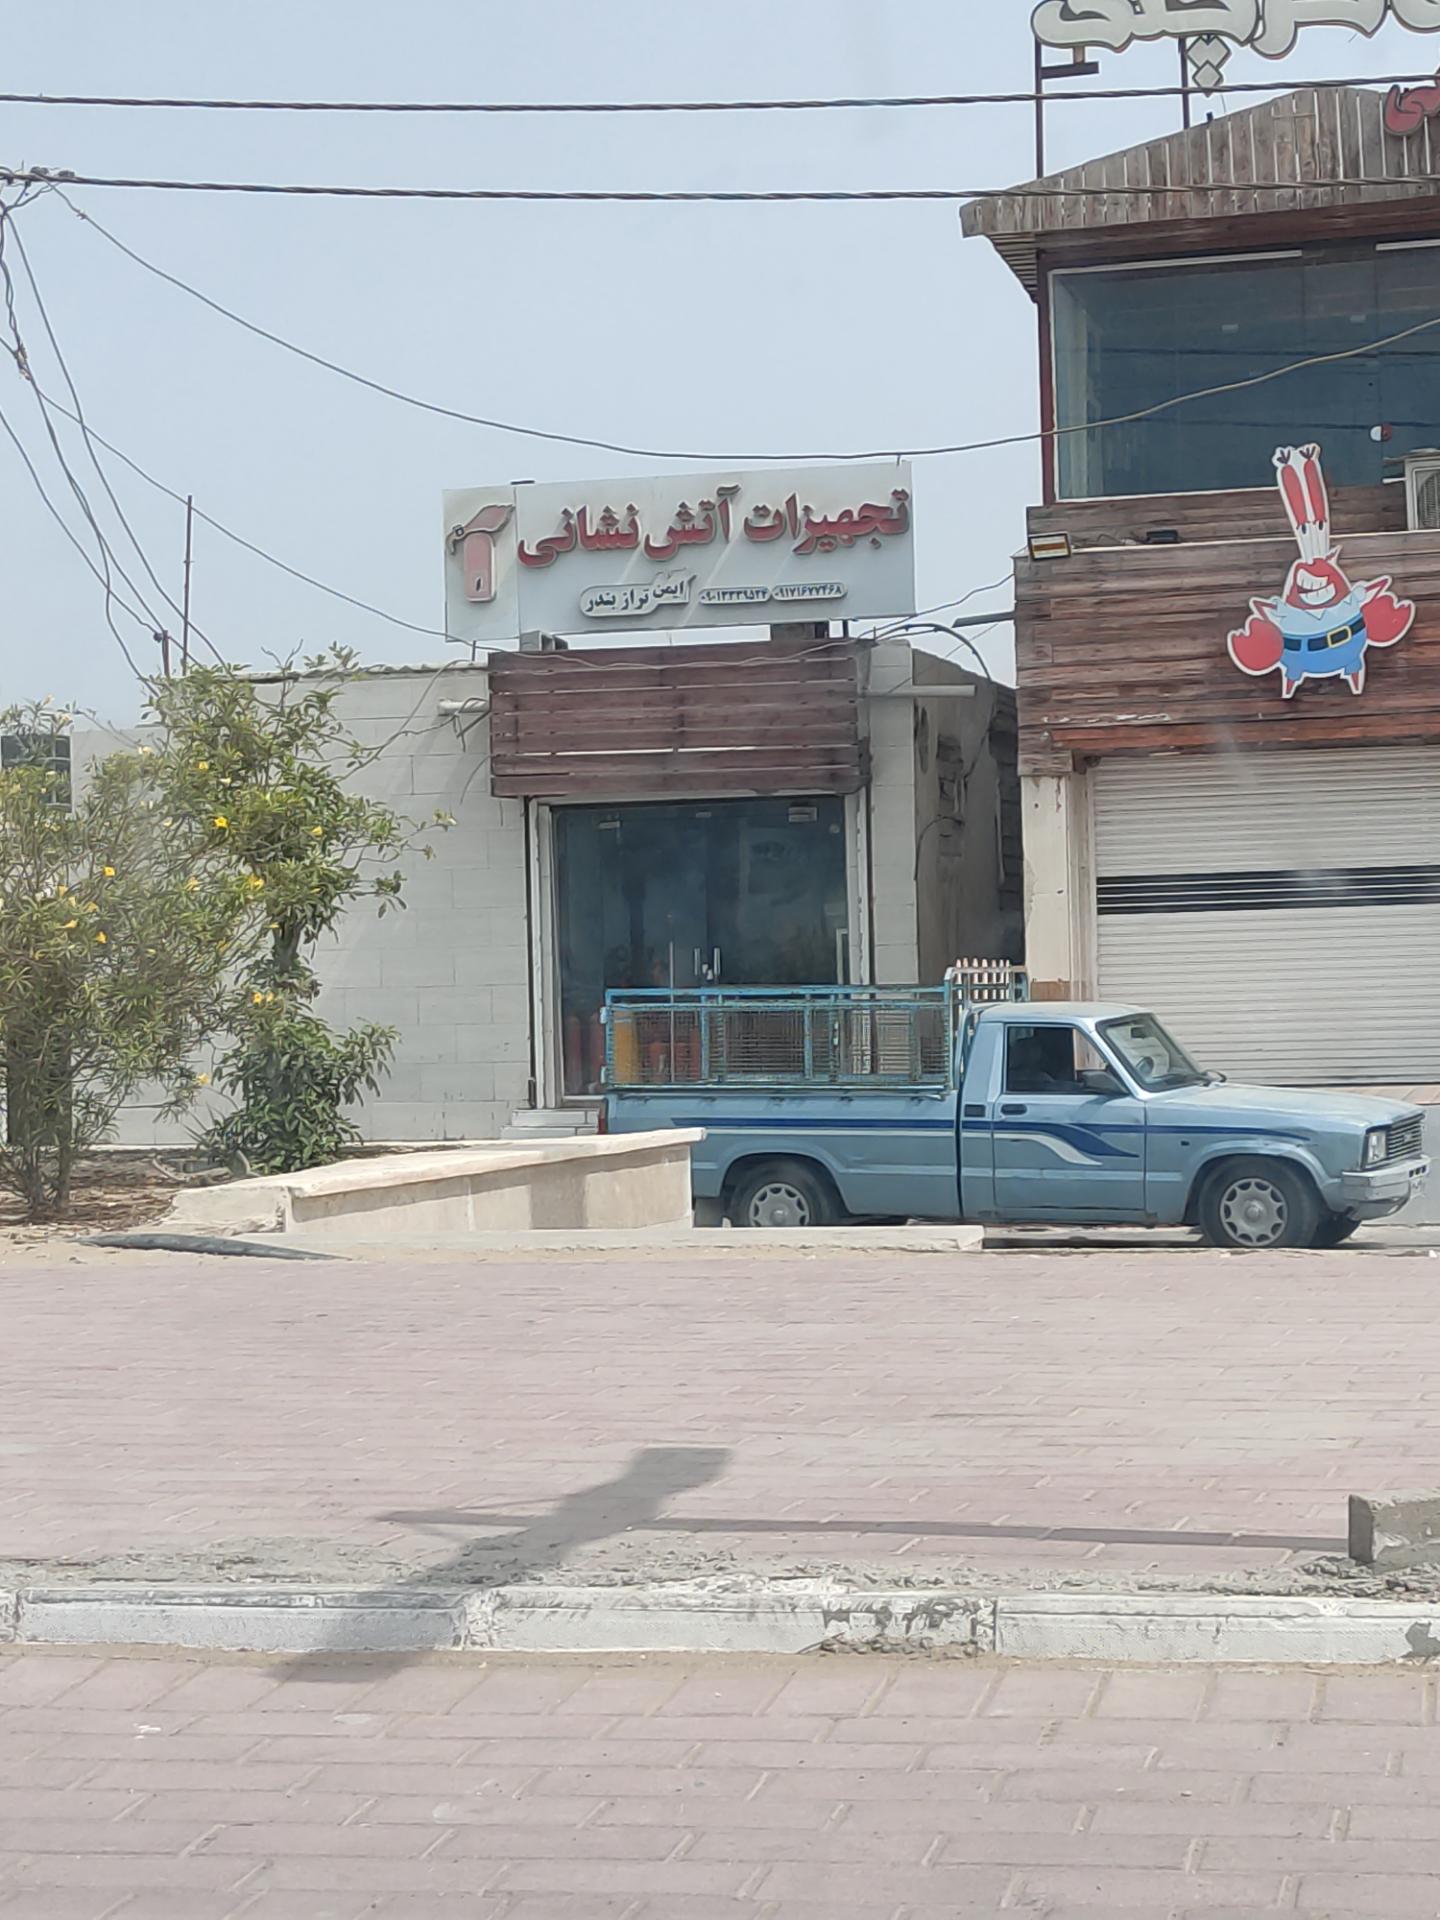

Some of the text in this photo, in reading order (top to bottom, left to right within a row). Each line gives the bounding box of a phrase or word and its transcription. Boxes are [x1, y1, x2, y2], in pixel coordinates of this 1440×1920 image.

[517, 484, 910, 568] تجهیزات آتش نشانی
[585, 580, 685, 612] ایمن تراز بندر
